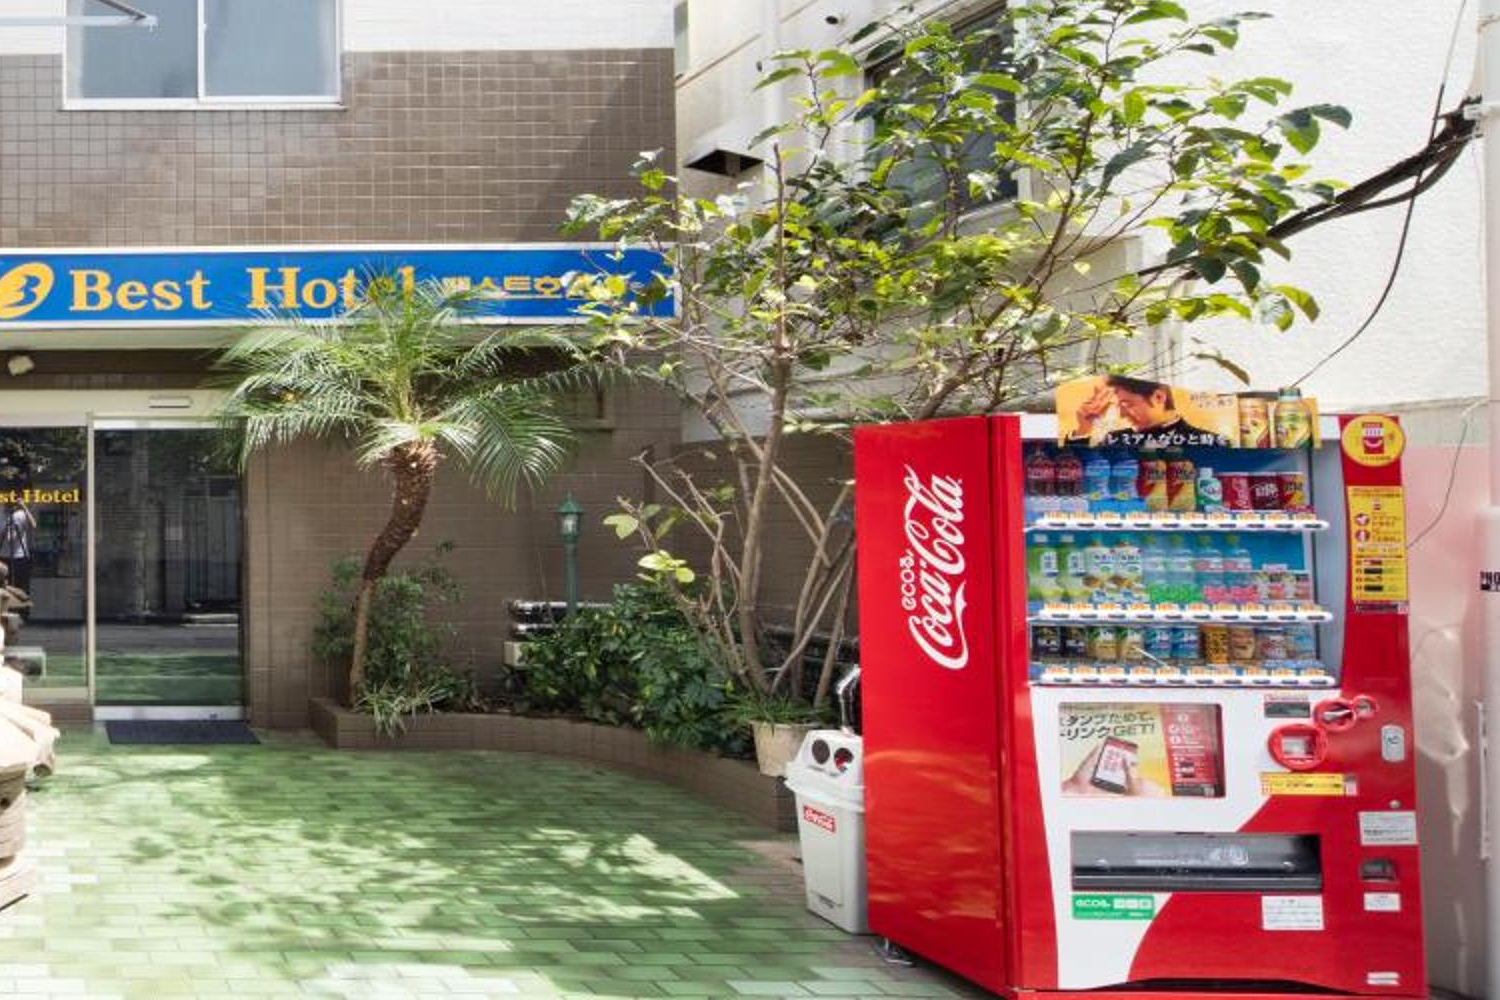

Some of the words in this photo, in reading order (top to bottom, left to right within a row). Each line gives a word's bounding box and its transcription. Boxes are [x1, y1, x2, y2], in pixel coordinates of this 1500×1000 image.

[69, 269, 213, 312] Best
[441, 275, 596, 300] 베스트호
[22, 488, 80, 505] Hotel
[904, 463, 969, 670] Coca-Cola
